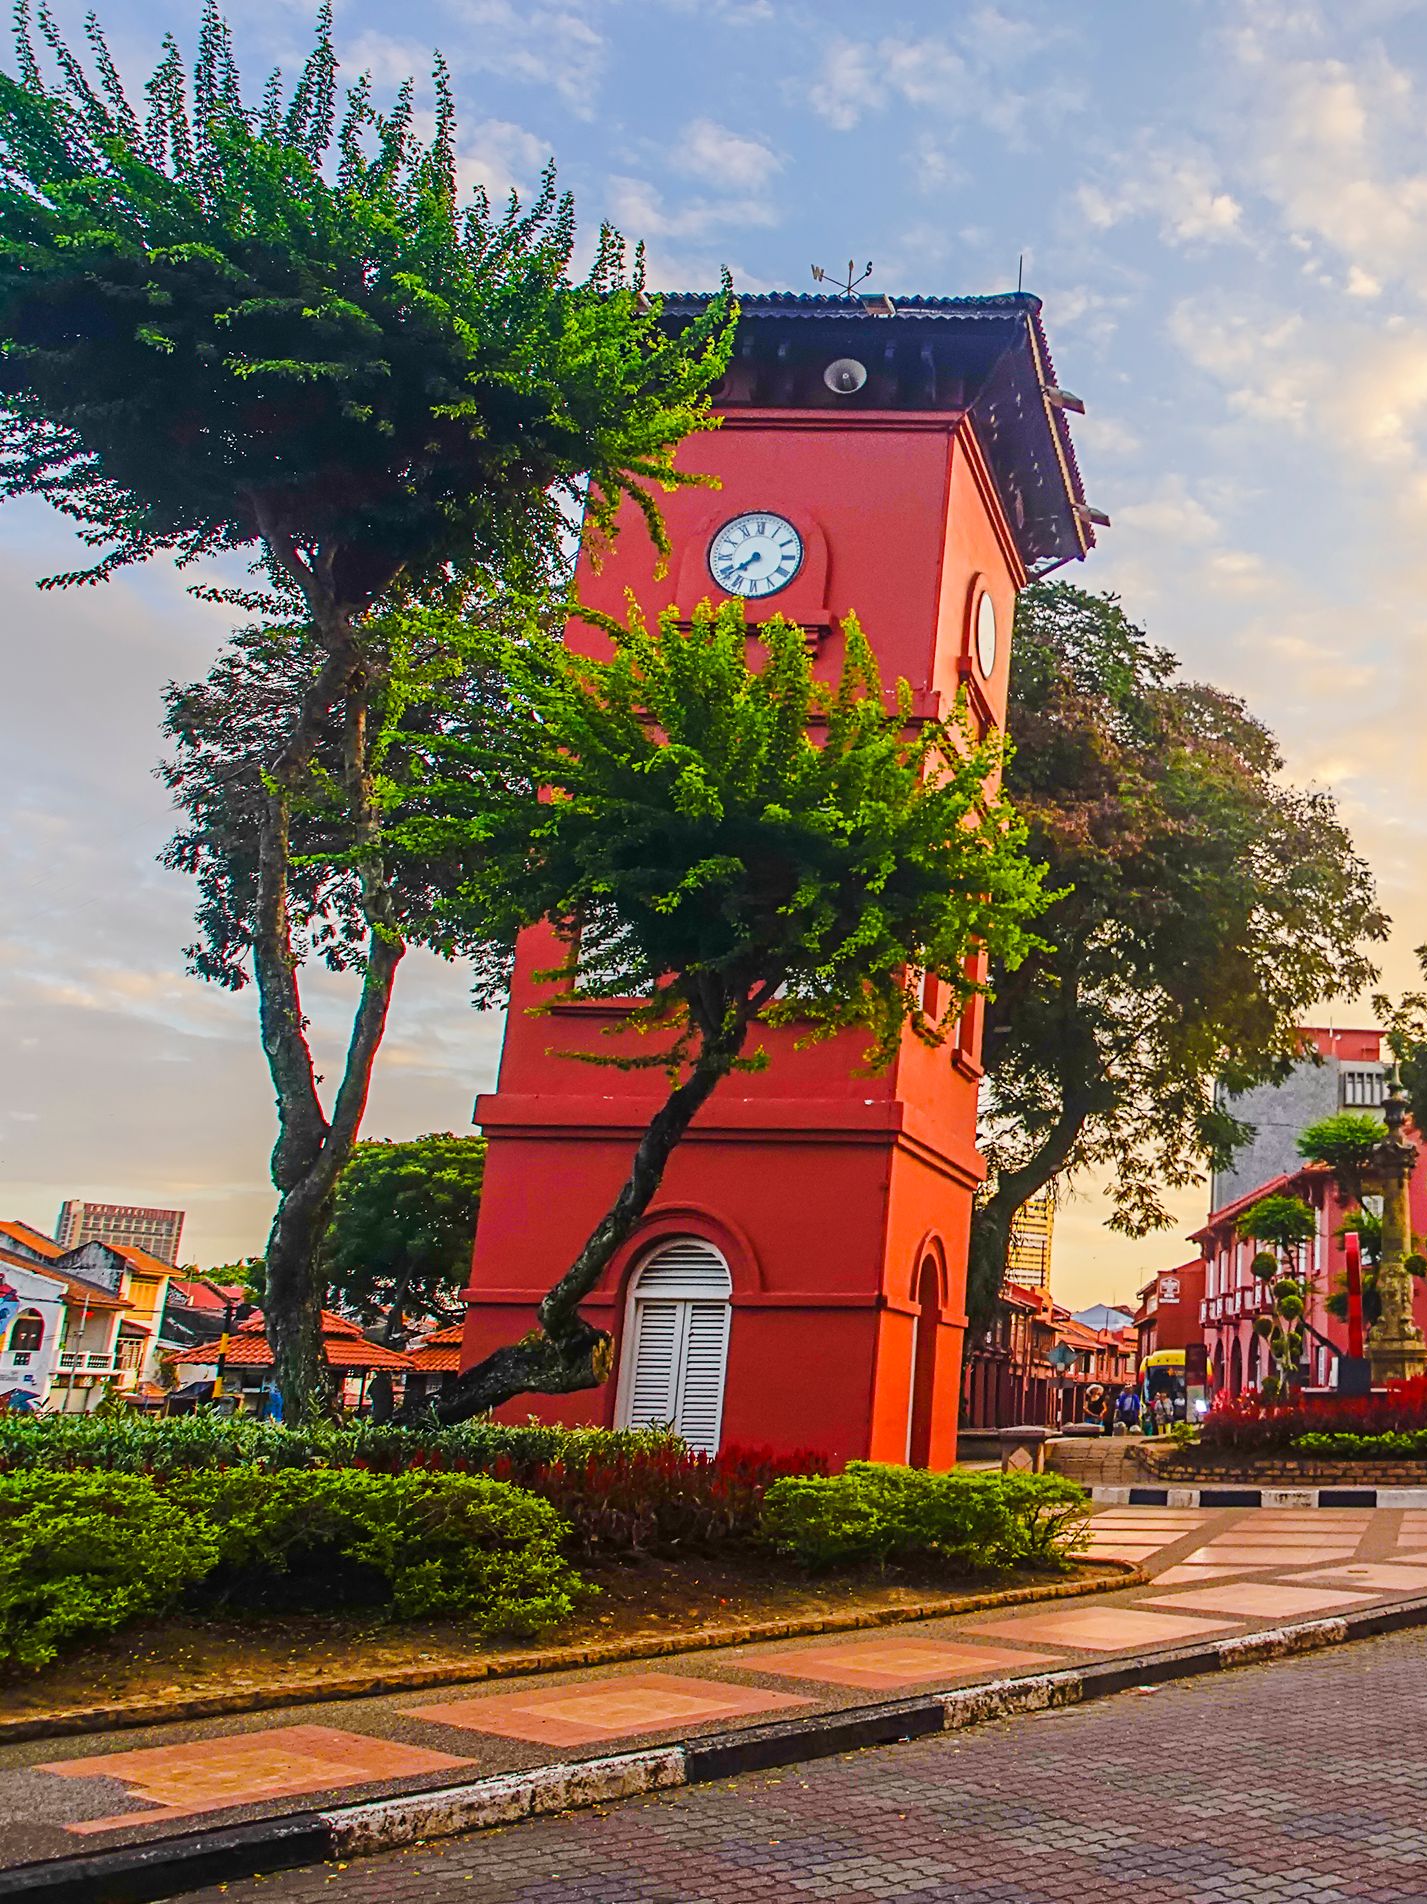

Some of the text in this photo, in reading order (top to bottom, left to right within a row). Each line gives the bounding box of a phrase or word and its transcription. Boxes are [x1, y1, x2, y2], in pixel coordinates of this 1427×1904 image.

[811, 264, 824, 282] W
[866, 261, 873, 276] S
[724, 535, 738, 548] X
[766, 576, 775, 589] V
